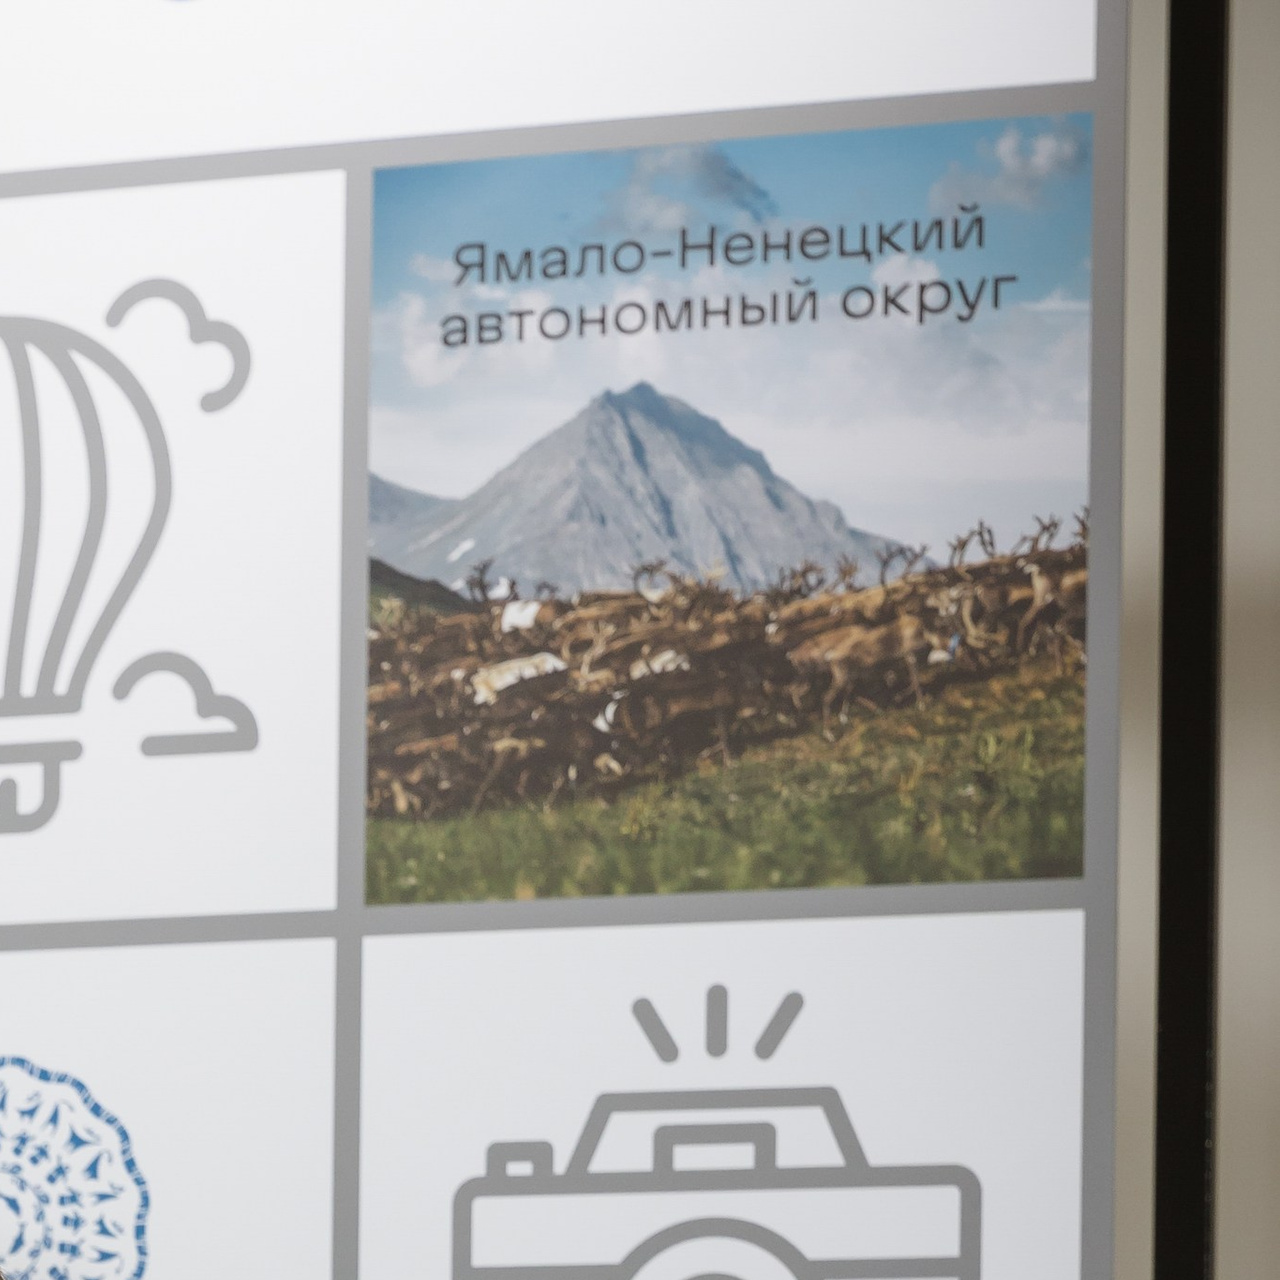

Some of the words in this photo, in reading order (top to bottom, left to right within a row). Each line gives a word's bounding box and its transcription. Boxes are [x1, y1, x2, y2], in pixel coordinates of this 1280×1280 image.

[452, 203, 986, 289] Ямало-Ненецкий
[441, 278, 819, 348] автономный
[841, 273, 1020, 325] округ
